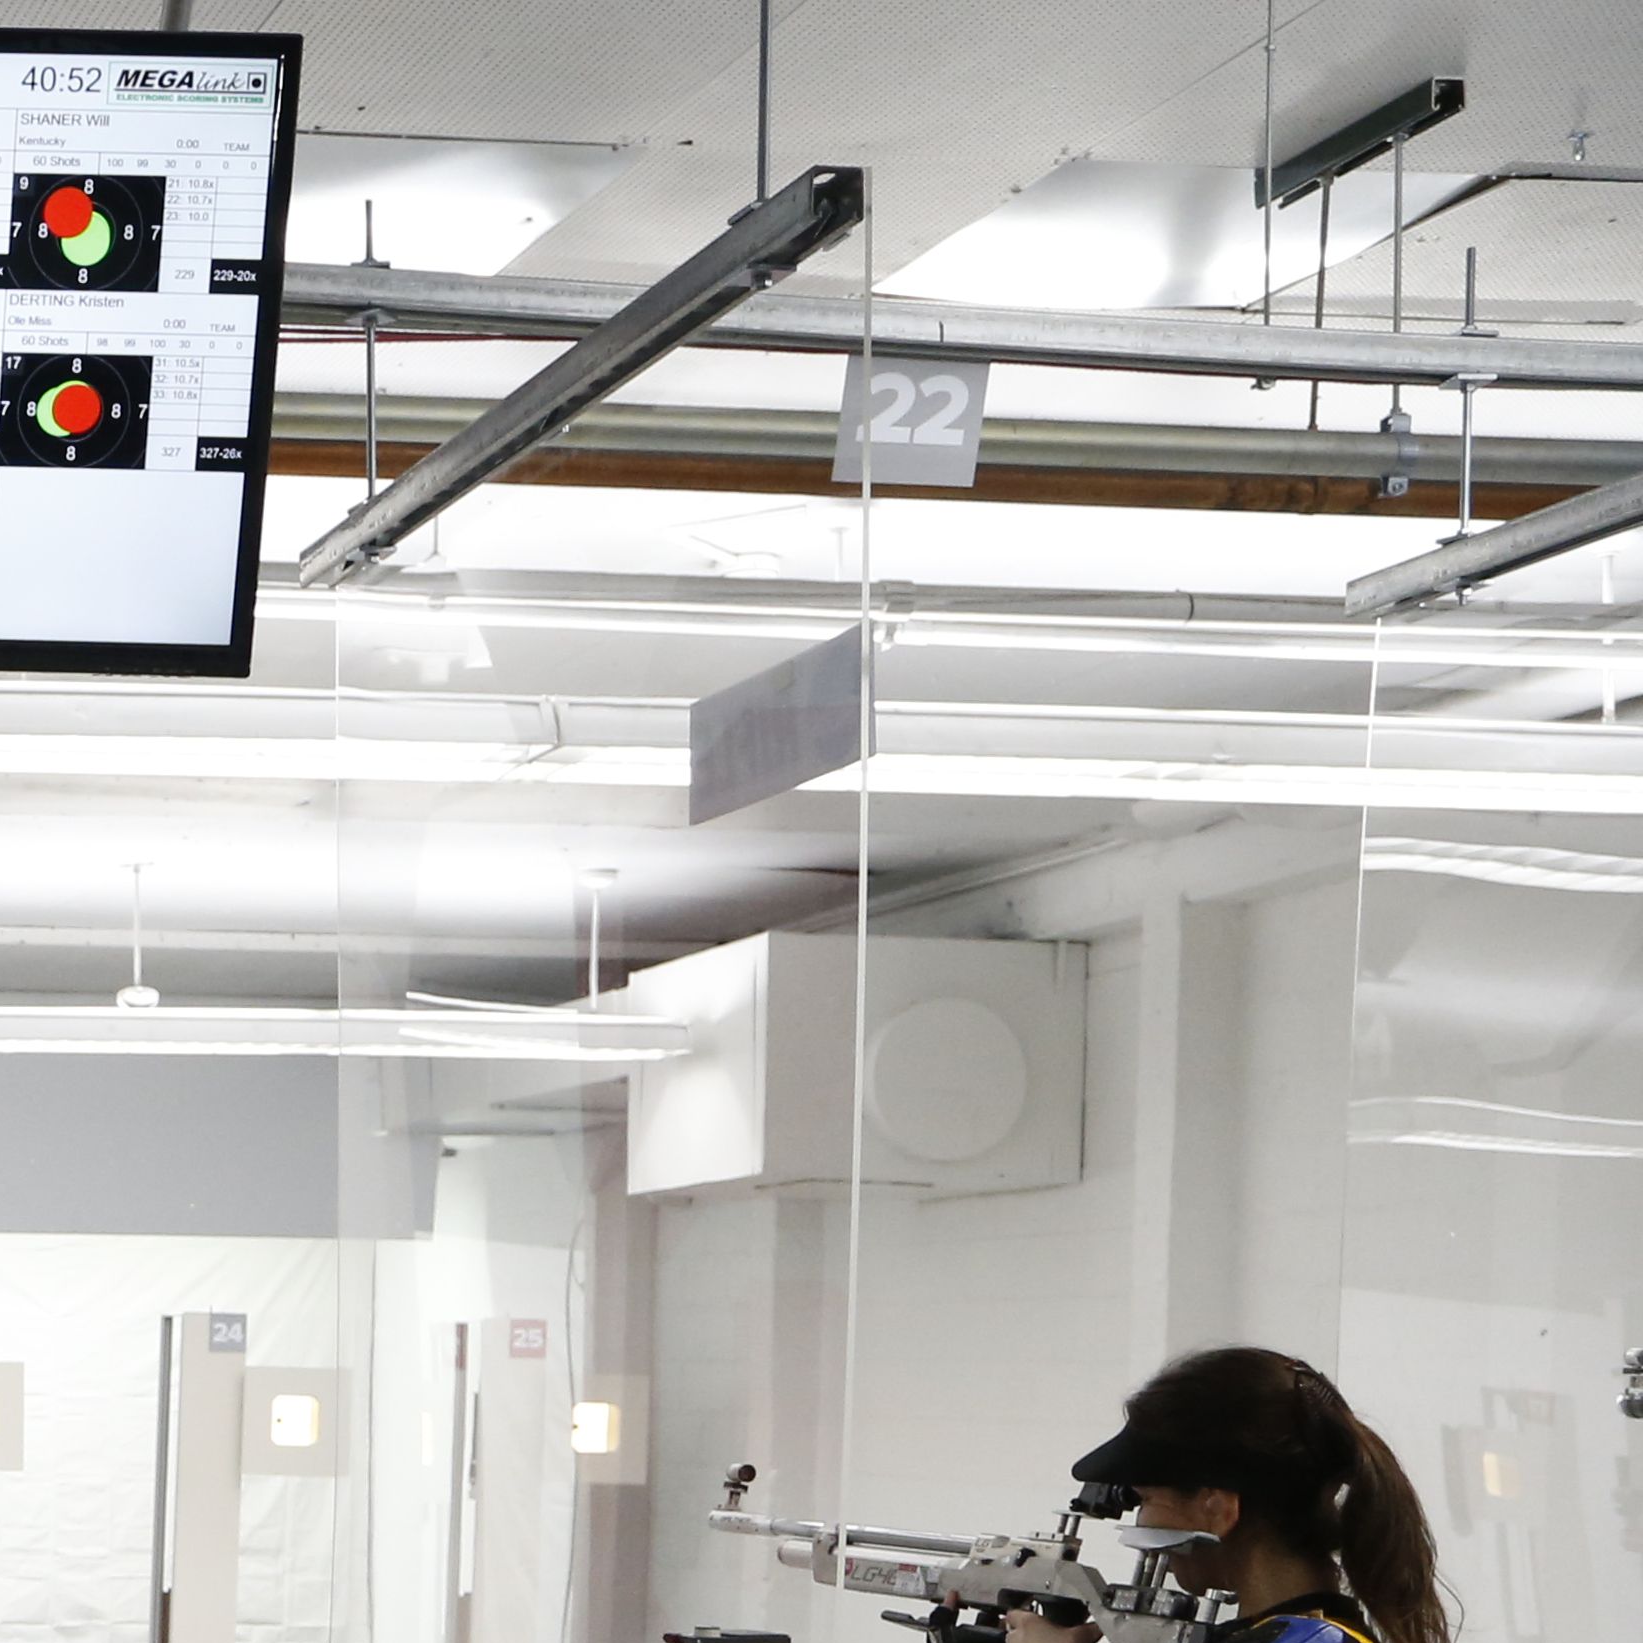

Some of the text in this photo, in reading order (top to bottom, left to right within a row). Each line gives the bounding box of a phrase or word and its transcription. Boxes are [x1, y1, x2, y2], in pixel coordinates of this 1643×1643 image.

[22, 67, 102, 92] 40:52
[21, 113, 110, 127] SHANER Will
[19, 135, 66, 148] Kentucky
[214, 269, 257, 281] 229-20x
[9, 294, 124, 309] DERTING Kristen
[8, 316, 52, 327] Ole Miss
[856, 372, 969, 446] 22
[212, 1322, 242, 1344] 24
[513, 1329, 543, 1348] 25
